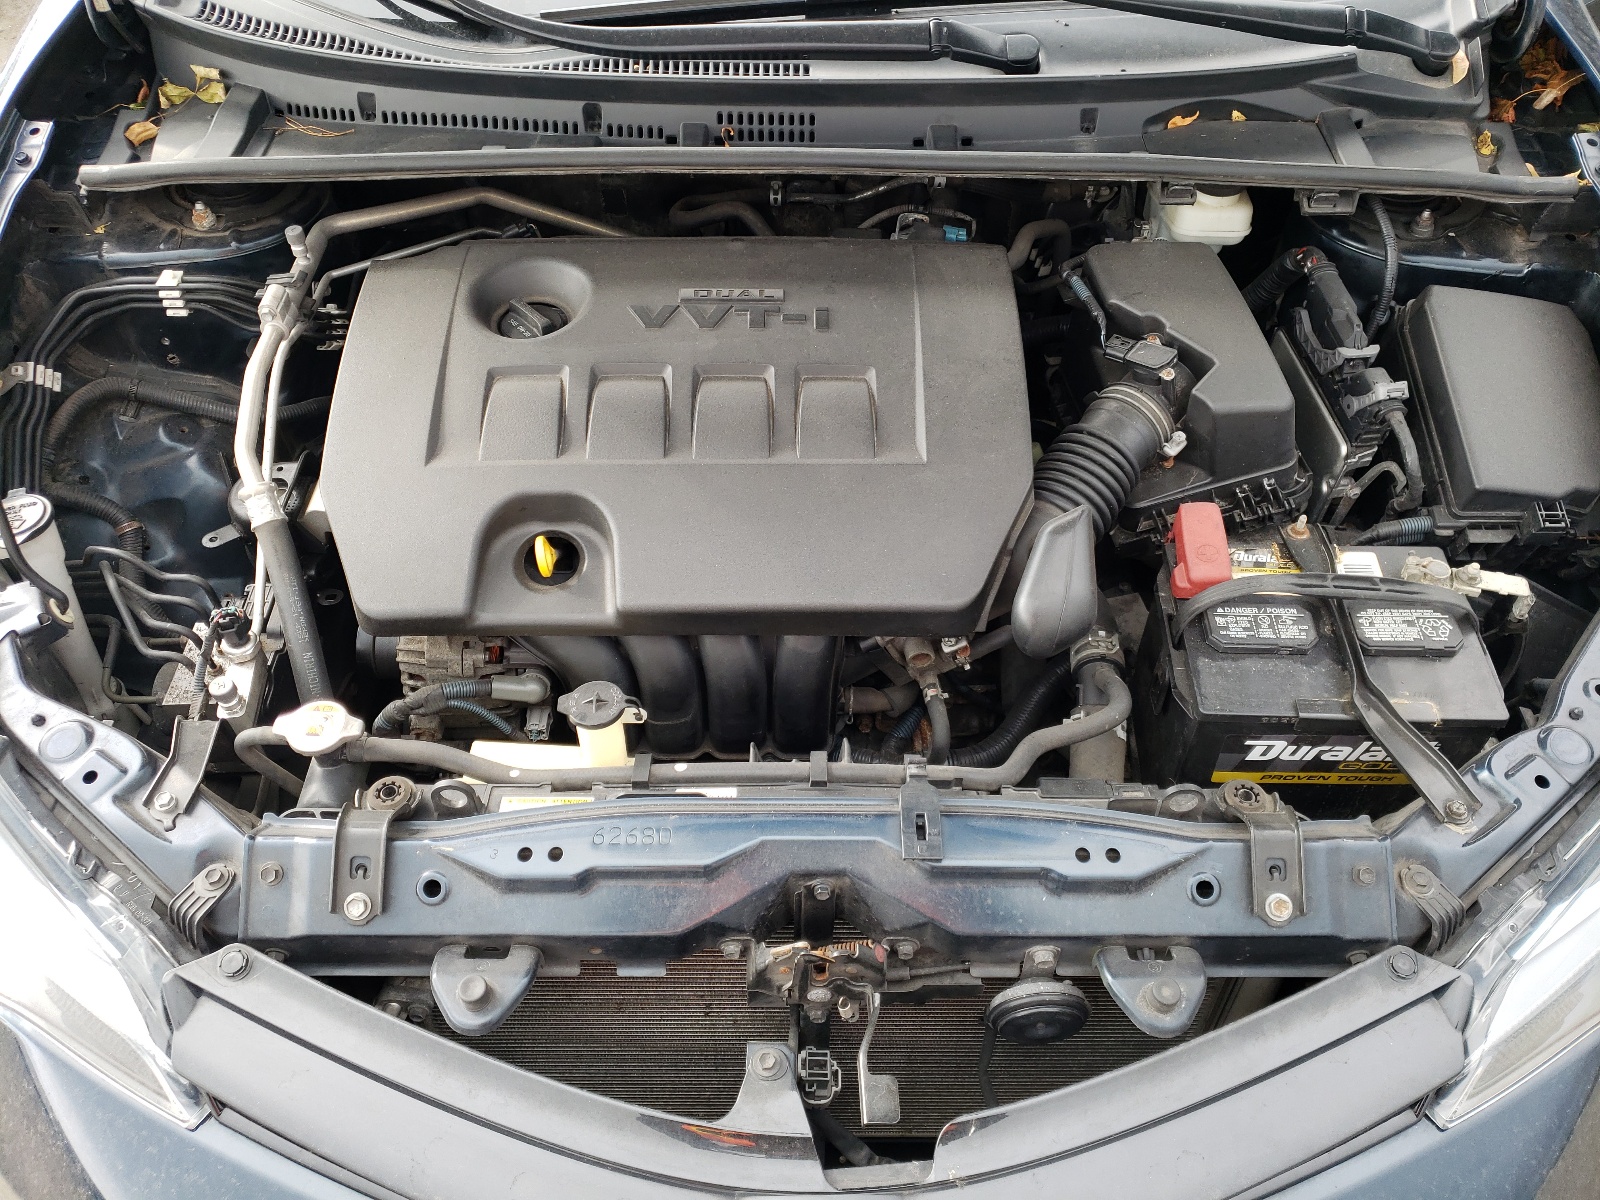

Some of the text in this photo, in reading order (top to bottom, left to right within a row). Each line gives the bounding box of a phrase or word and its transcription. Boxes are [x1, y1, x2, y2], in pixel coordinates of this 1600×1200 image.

[692, 288, 776, 299] DUAL
[1233, 551, 1278, 563] Durala
[1243, 740, 1441, 762] Durala
[1337, 761, 1400, 770] GOL
[1259, 774, 1396, 782] PROVEN TOUGH
[592, 825, 673, 846] 62680
